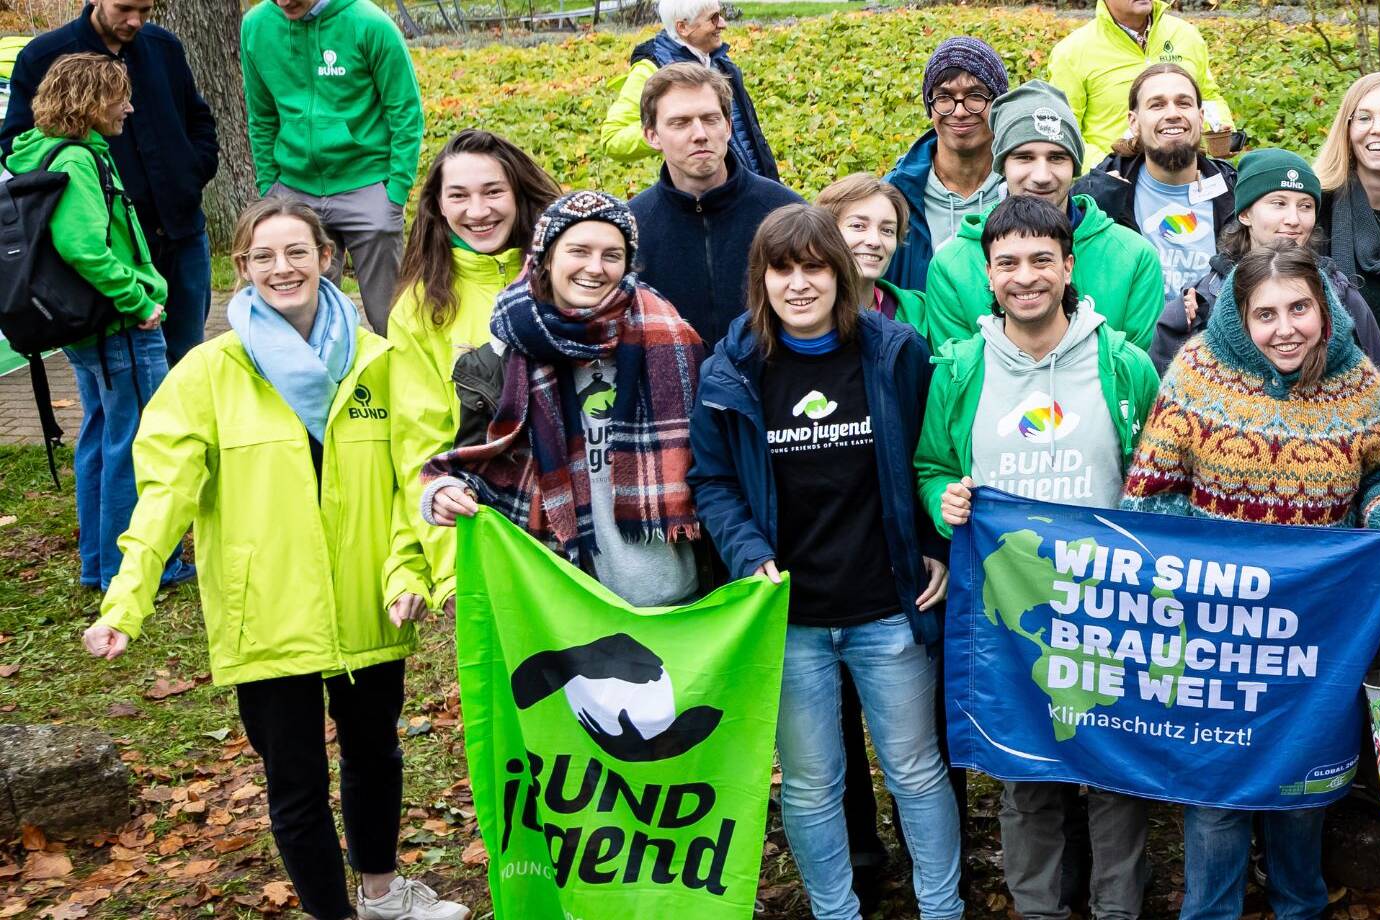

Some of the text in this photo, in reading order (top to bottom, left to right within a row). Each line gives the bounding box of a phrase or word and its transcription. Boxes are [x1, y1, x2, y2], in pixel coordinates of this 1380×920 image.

[318, 66, 346, 76] BUND
[1280, 181, 1304, 189] BUND
[1161, 248, 1210, 270] UND
[348, 407, 388, 419] BUND
[767, 416, 872, 443] BUND jugend
[791, 444, 821, 452] FRIENDS
[851, 438, 874, 446] EARTH
[1000, 449, 1083, 475] BUND
[1054, 539, 1271, 600] WIR SIND
[1049, 581, 1299, 639] JUNG UND
[1051, 617, 1319, 677] BRAUCHEN
[1047, 655, 1268, 712] DIE WELT
[1048, 703, 1253, 745] Klimaschutz jetzt!
[1314, 766, 1345, 777] GLOBAL
